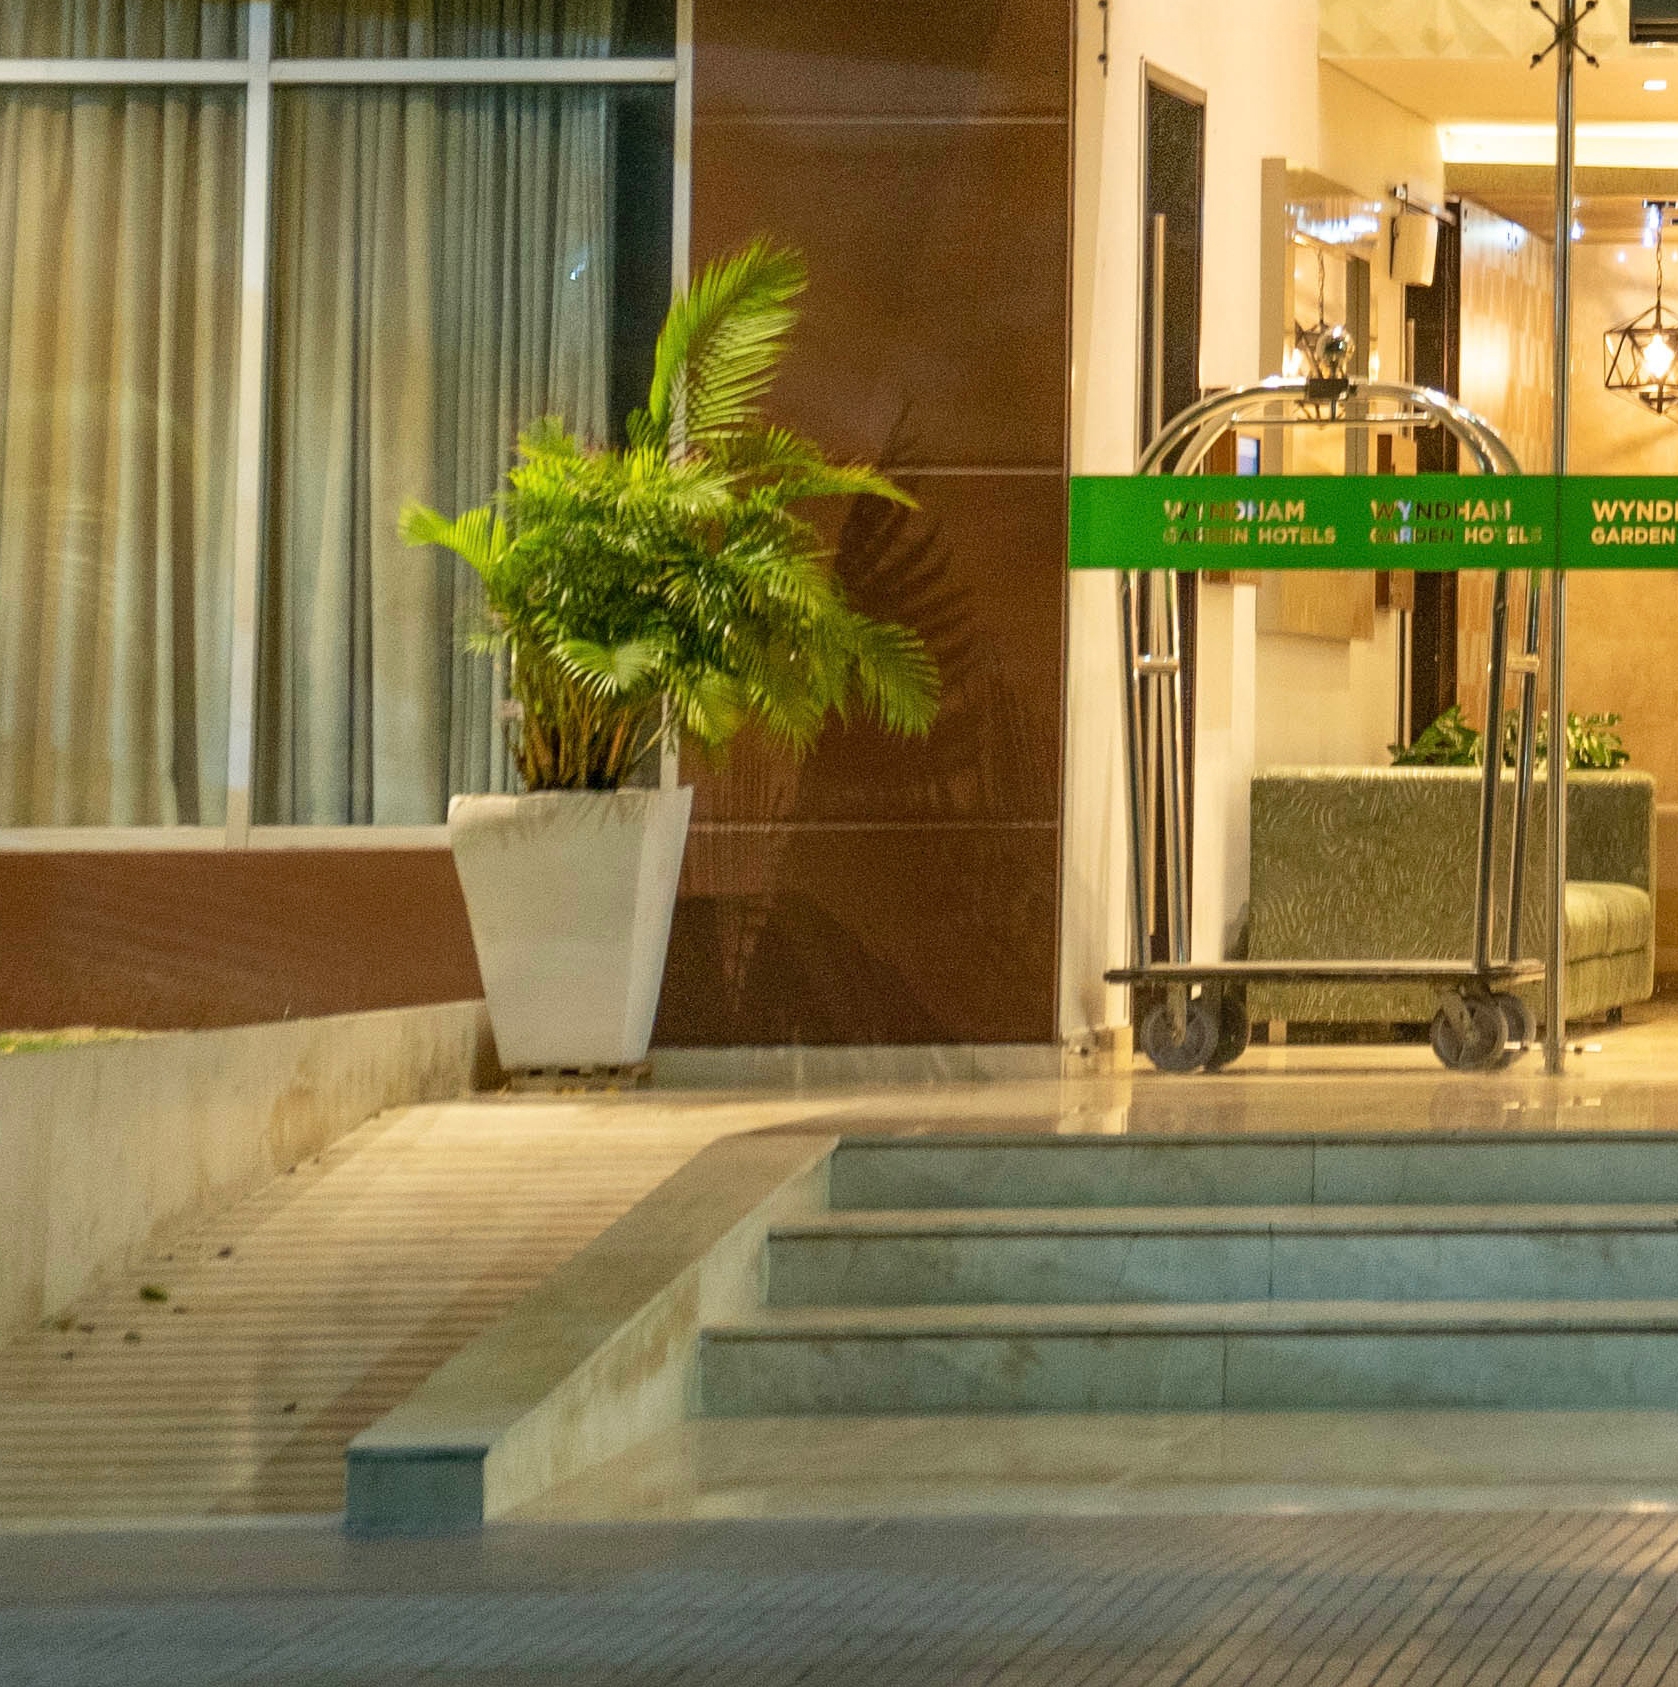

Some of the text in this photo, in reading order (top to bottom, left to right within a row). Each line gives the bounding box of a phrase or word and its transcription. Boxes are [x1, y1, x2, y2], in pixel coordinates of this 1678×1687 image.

[1370, 499, 1511, 522] WYNDHAM
[1258, 526, 1336, 544] HOTELS
[1591, 526, 1677, 544] GARDEN
